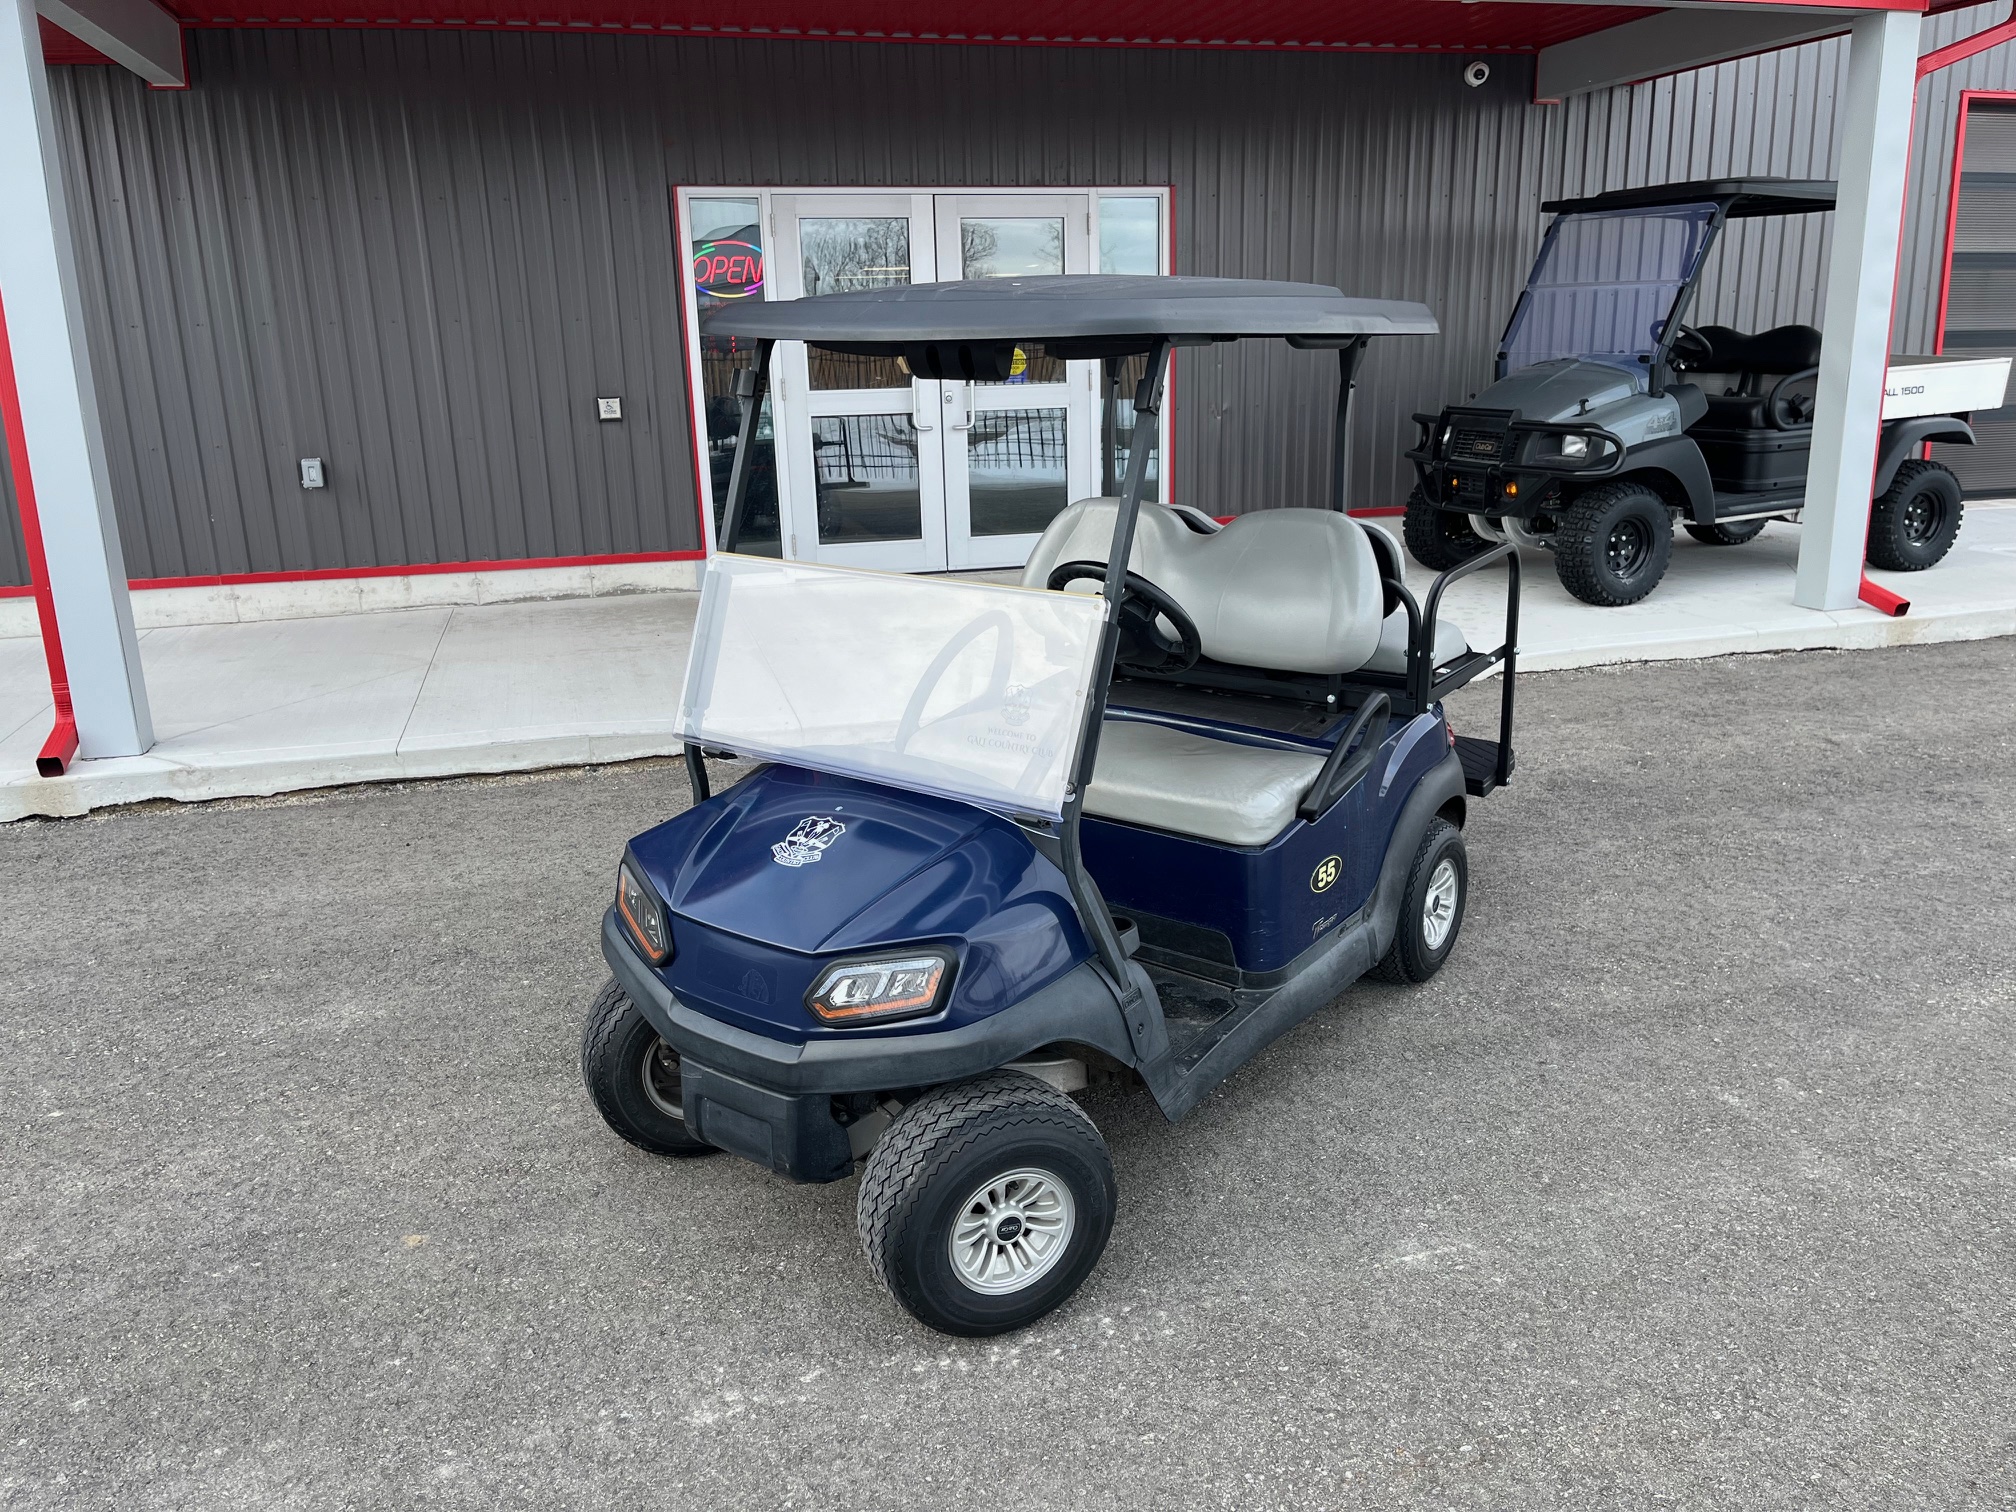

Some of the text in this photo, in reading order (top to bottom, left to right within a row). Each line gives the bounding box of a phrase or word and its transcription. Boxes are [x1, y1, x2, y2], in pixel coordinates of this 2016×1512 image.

[694, 256, 763, 283] OPEN
[1901, 385, 1925, 396] 1500
[987, 726, 1037, 742] WELCOME TO
[988, 738, 1030, 754] COUNTRY
[1031, 746, 1054, 758] CLUB
[1317, 860, 1336, 888] 55
